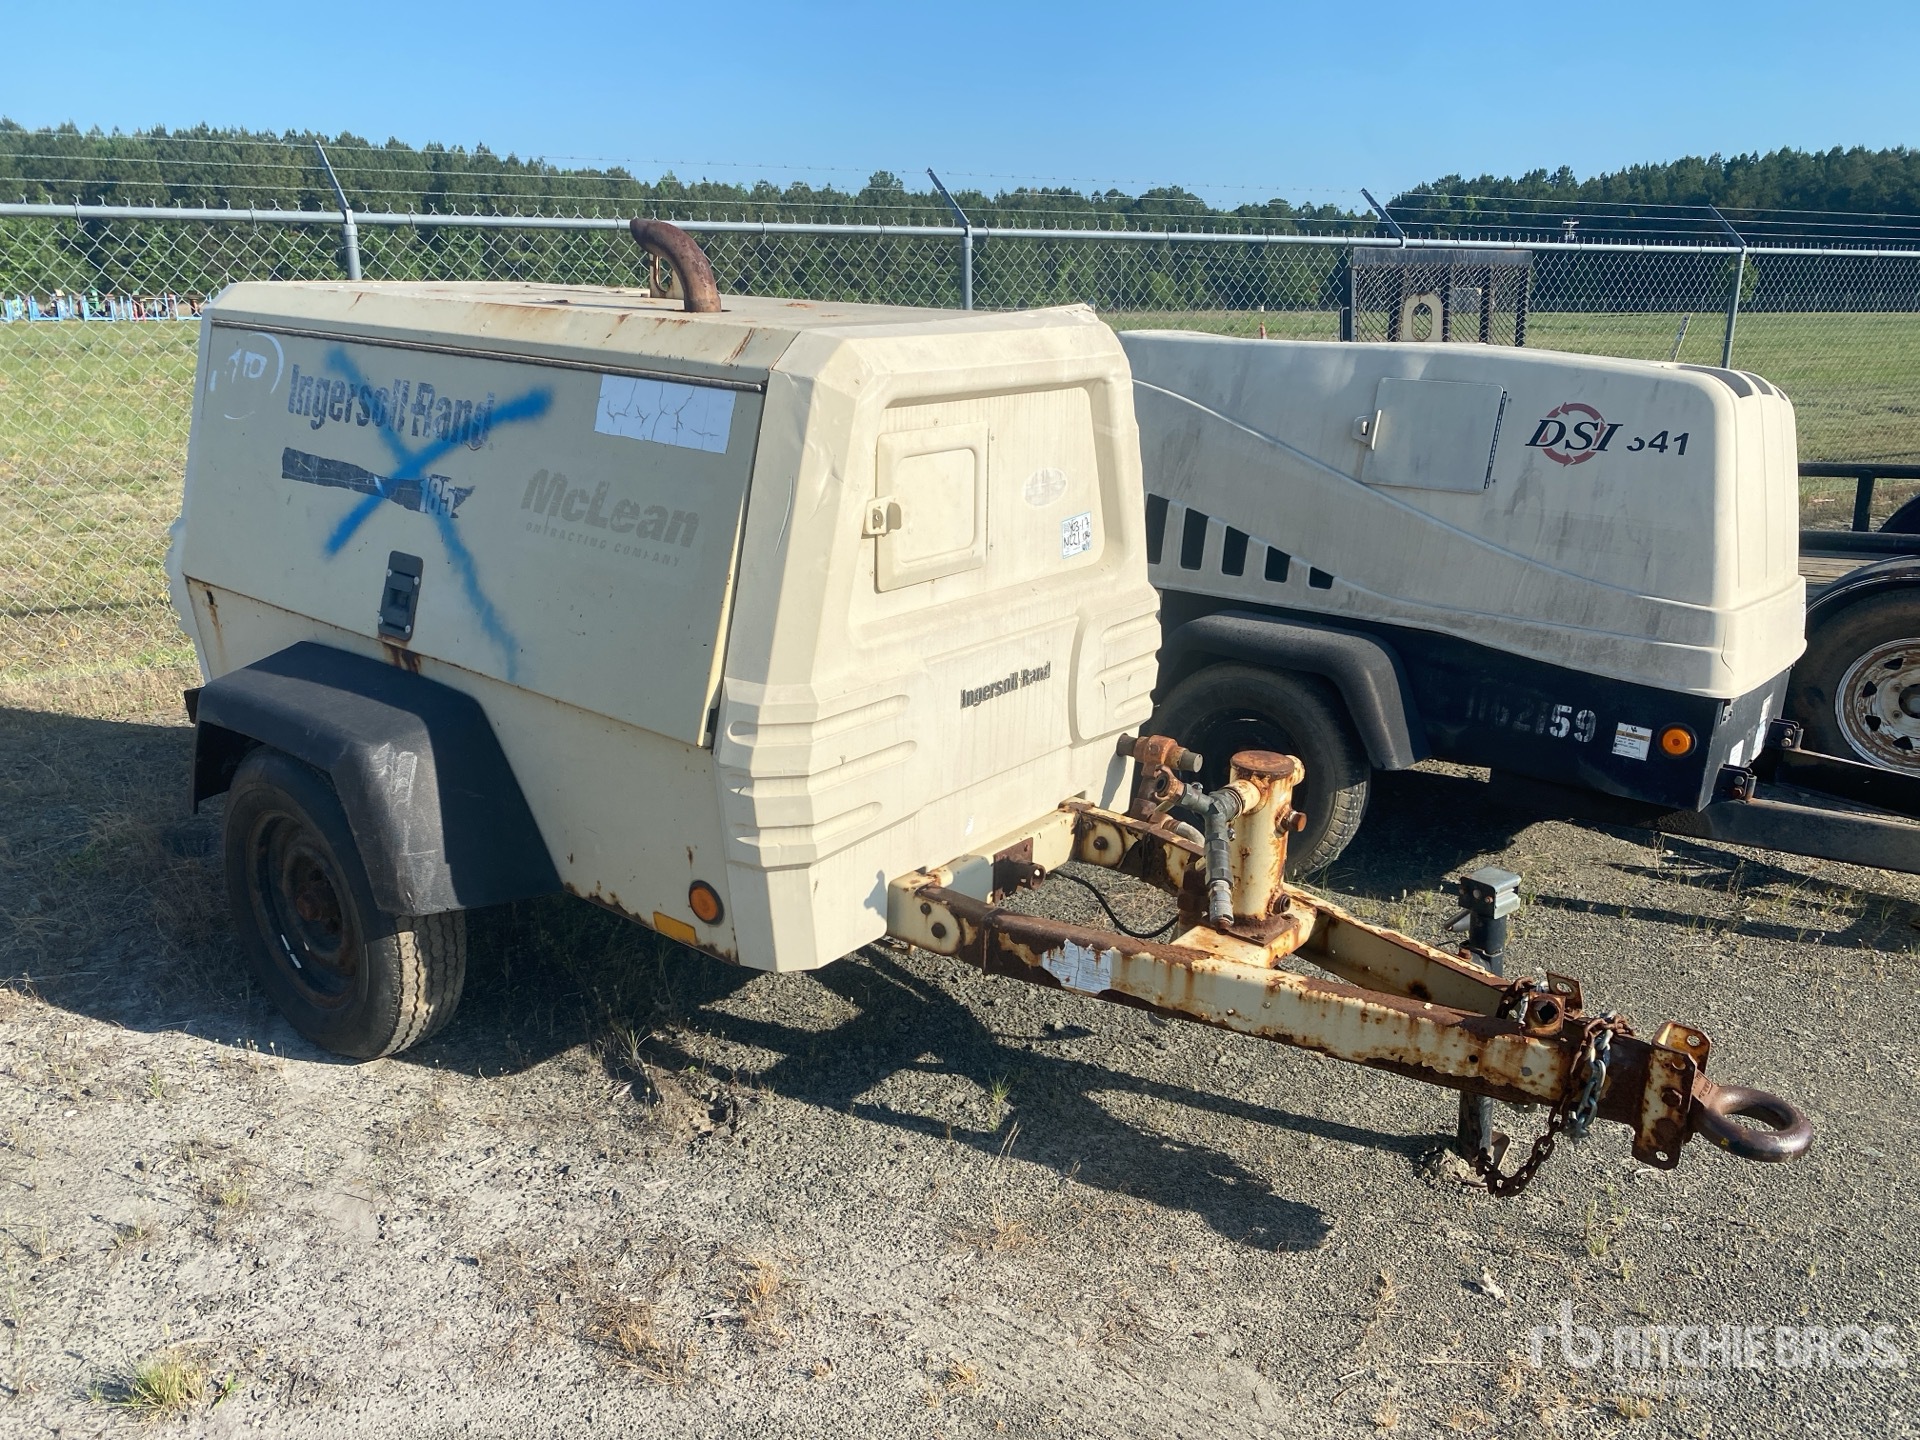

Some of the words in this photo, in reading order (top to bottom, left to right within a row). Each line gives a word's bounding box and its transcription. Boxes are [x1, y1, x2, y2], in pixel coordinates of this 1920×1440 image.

[1525, 418, 1624, 452] DSI
[419, 477, 456, 518] 185
[520, 468, 700, 549] McLean
[960, 671, 1019, 709] Ingersoll
